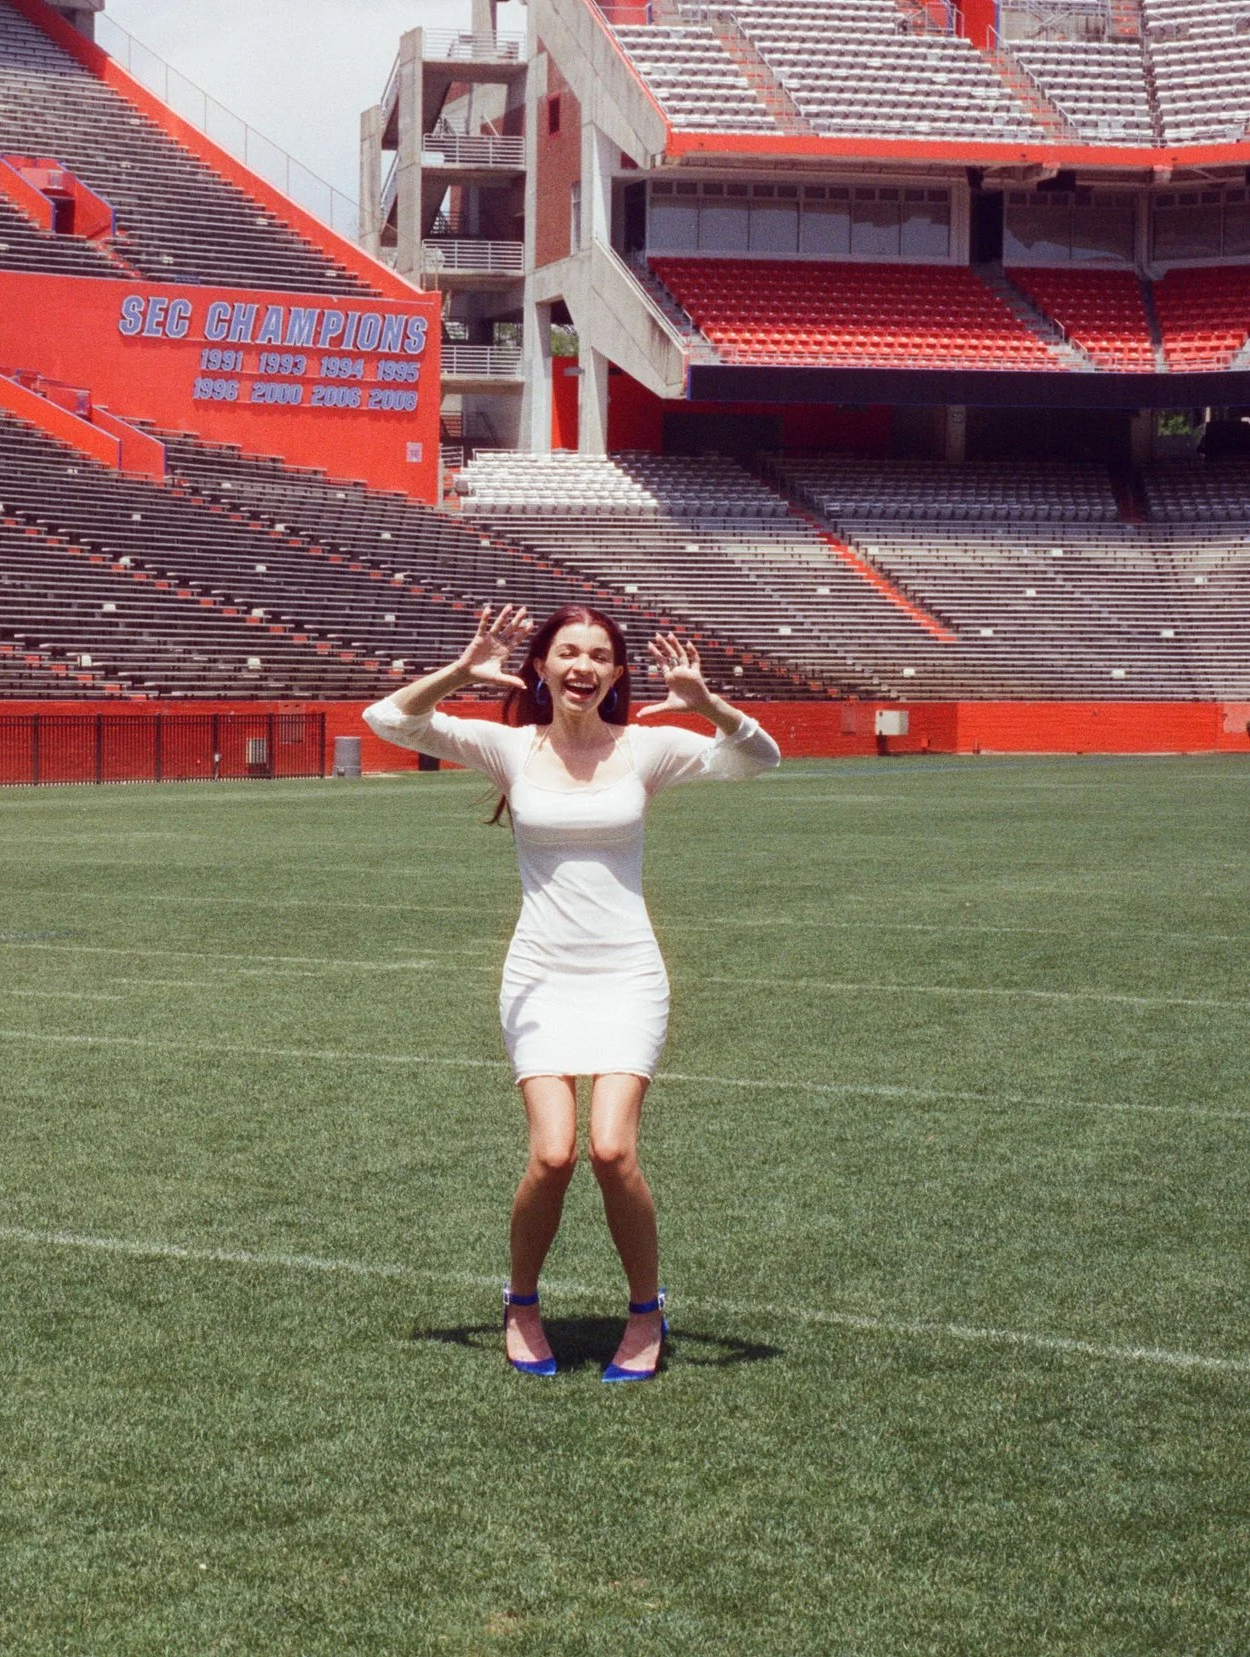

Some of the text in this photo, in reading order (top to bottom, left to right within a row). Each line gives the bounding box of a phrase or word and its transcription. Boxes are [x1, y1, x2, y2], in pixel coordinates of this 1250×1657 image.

[118, 294, 428, 355] SEC CHAMPIONS
[200, 349, 421, 383] 1991 1993 1994 1995
[193, 377, 418, 411] 1996 2000 2006 2008
